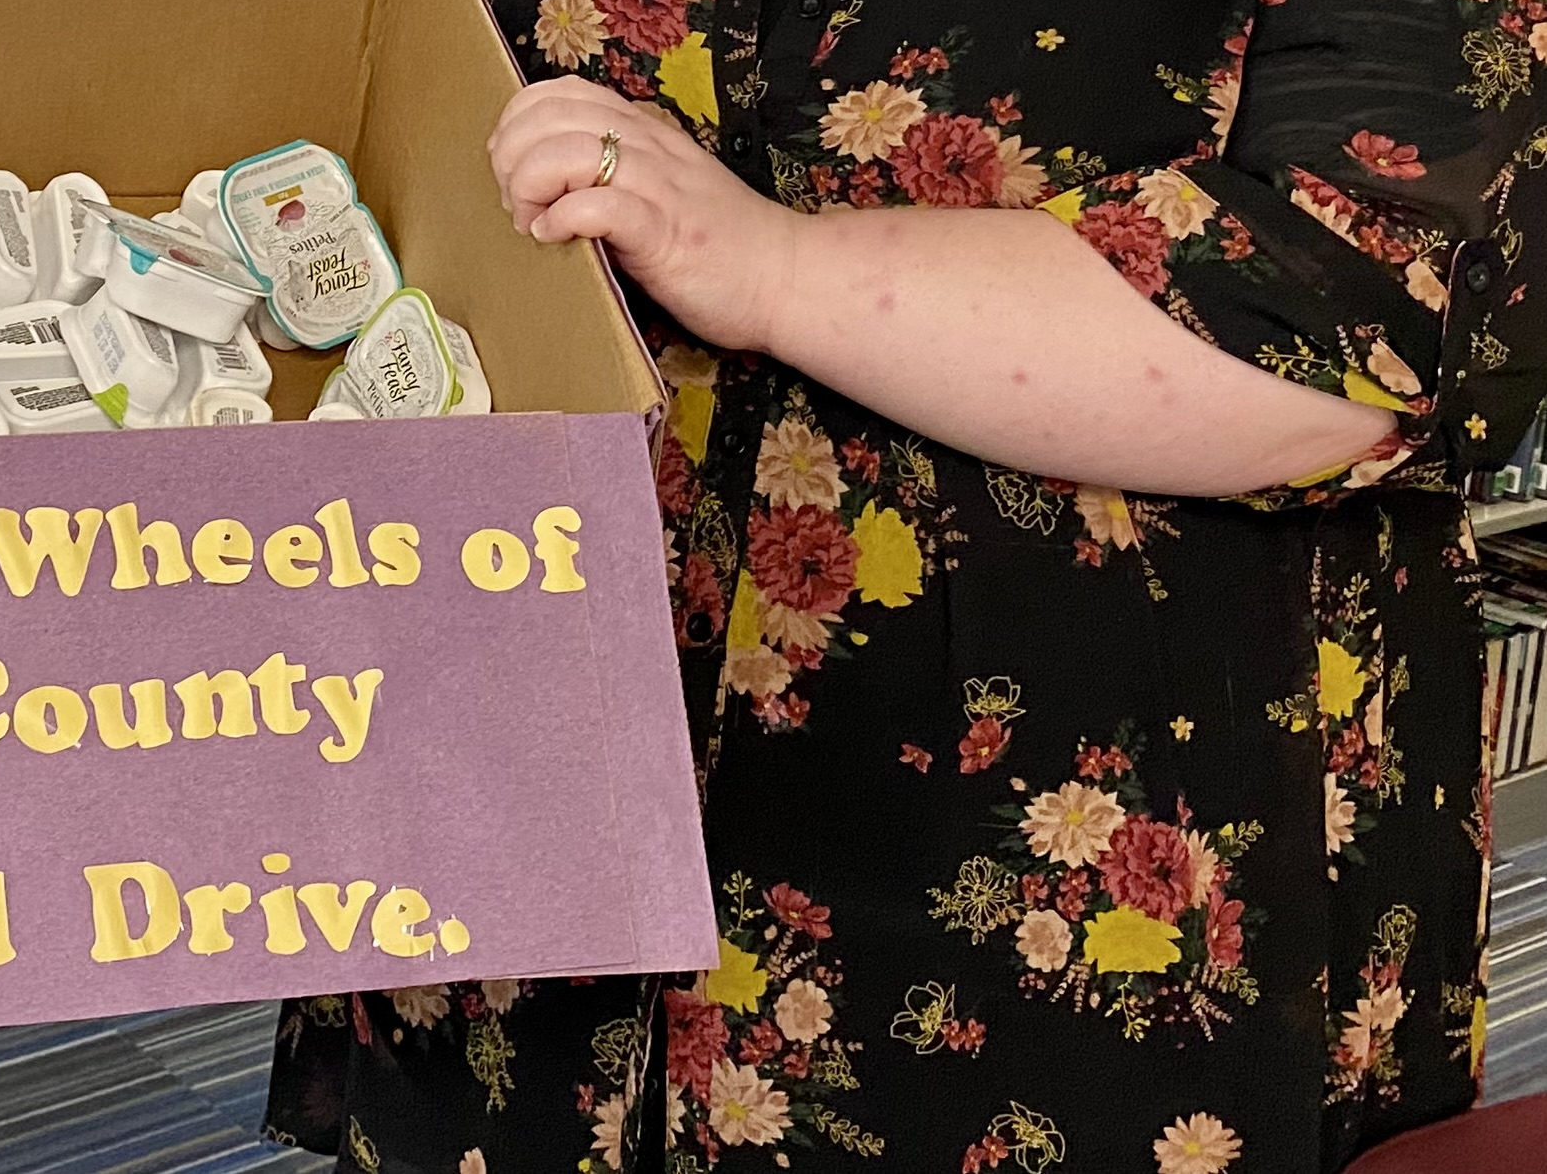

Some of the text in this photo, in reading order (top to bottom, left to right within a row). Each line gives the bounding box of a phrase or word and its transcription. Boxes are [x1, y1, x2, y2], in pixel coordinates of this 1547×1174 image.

[289, 231, 338, 255] Petites
[306, 246, 354, 281] Feast
[313, 263, 371, 300] Fancy
[393, 328, 420, 392] Fancy
[380, 361, 408, 405] Feast
[461, 506, 587, 593] of
[83, 853, 471, 962] Drive.
